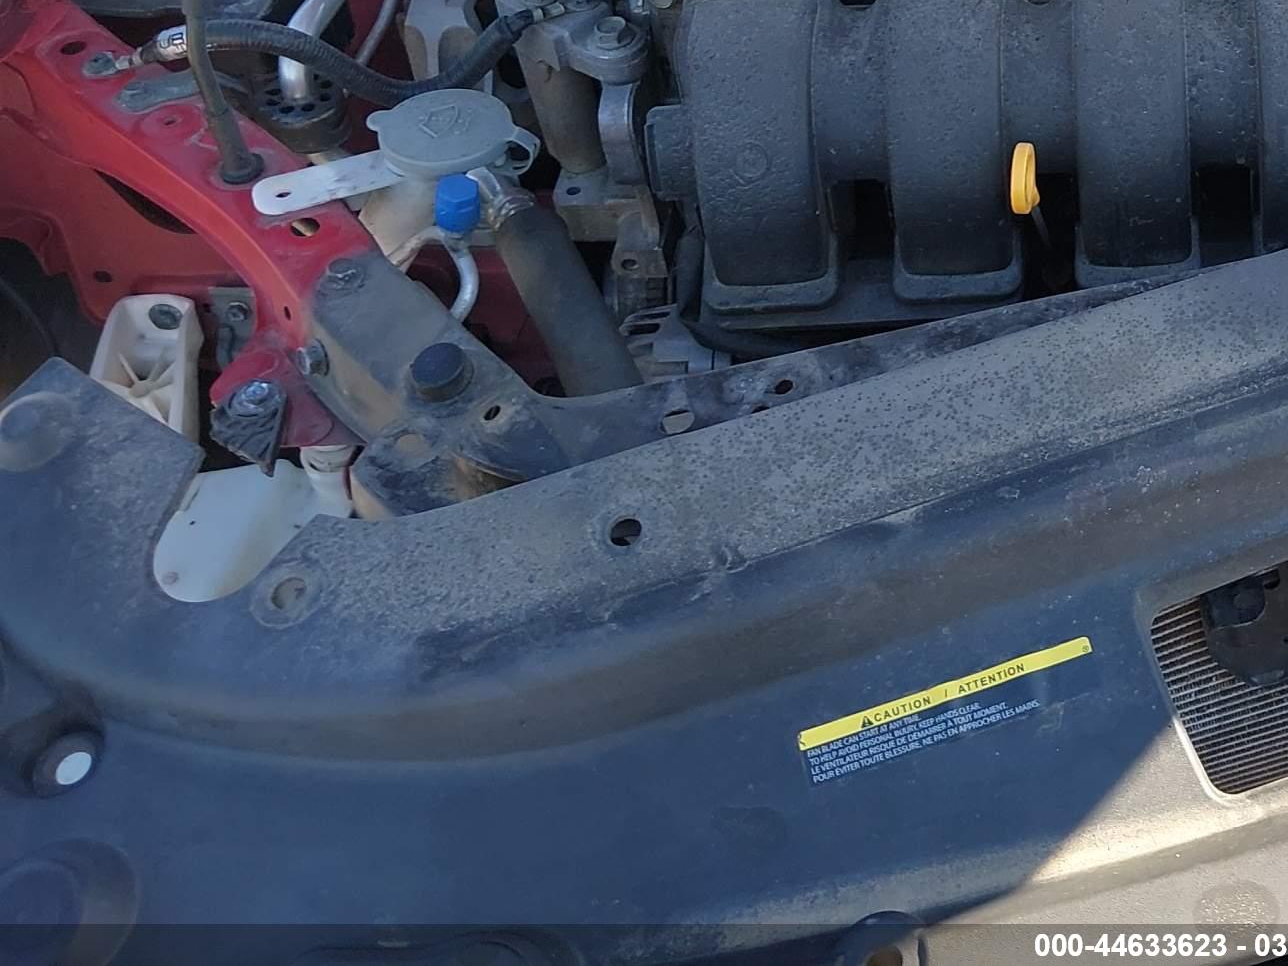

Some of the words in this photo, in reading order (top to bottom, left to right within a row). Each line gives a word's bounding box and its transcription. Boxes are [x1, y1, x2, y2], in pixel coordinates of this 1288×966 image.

[873, 695, 931, 722] CAUTION
[944, 689, 949, 698] /
[958, 663, 1025, 694] ATTENTION
[807, 747, 820, 757] FAN
[821, 739, 843, 752] BLADE
[843, 735, 858, 745] CAN
[858, 728, 879, 740] START
[878, 724, 888, 733] AT
[888, 719, 903, 730] ANY
[903, 714, 920, 725] TIME.
[810, 756, 820, 766] TO
[819, 750, 837, 762] HELP
[837, 743, 859, 756] AVOID
[859, 731, 894, 749] PERSONAL
[918, 717, 935, 729] KEEP
[935, 709, 959, 723] HANDS
[811, 765, 821, 774] LE
[820, 749, 869, 771] VENTILATEUR
[869, 740, 896, 755] RISQUE
[896, 736, 907, 745] DE
[953, 713, 973, 726] TOUT
[973, 701, 1008, 719] MOMENT.
[813, 770, 835, 783] POUR
[859, 753, 885, 767] TOUTE
[922, 736, 933, 745] NE
[933, 731, 947, 741] PAS
[947, 727, 958, 736] EN
[958, 713, 1001, 733] APPROCHER
[1002, 708, 1015, 718] LES
[1015, 699, 1040, 713] MAINS.
